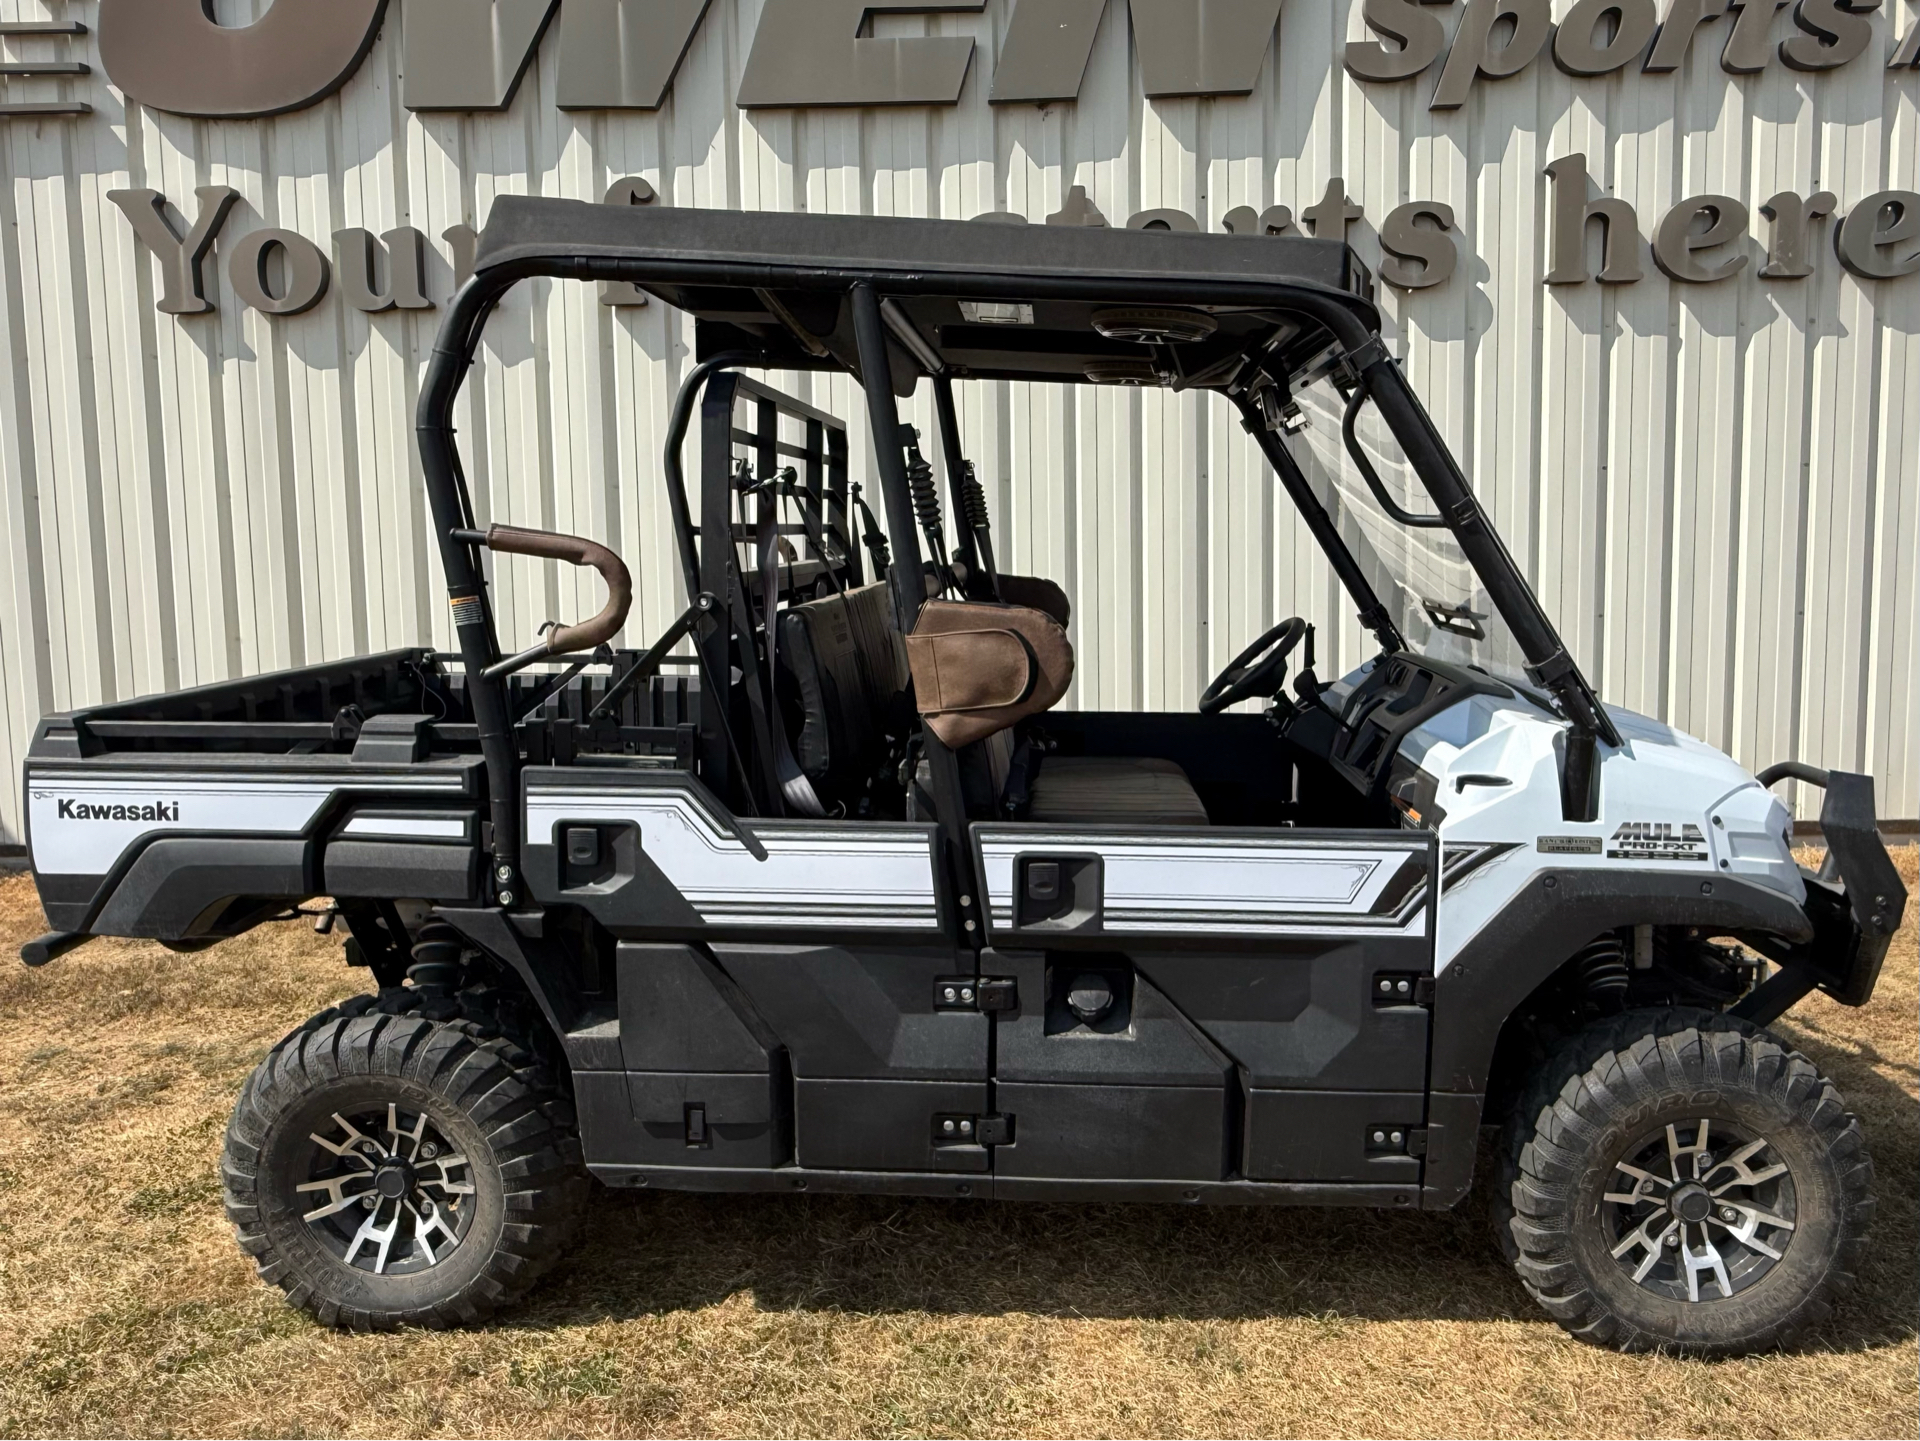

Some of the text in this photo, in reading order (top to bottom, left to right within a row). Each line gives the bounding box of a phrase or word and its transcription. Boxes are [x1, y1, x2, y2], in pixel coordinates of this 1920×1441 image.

[1542, 152, 1920, 285] here
[58, 799, 179, 821] Kawasaki
[1609, 822, 1707, 843] MULE
[1618, 841, 1698, 851] PRO-FXT
